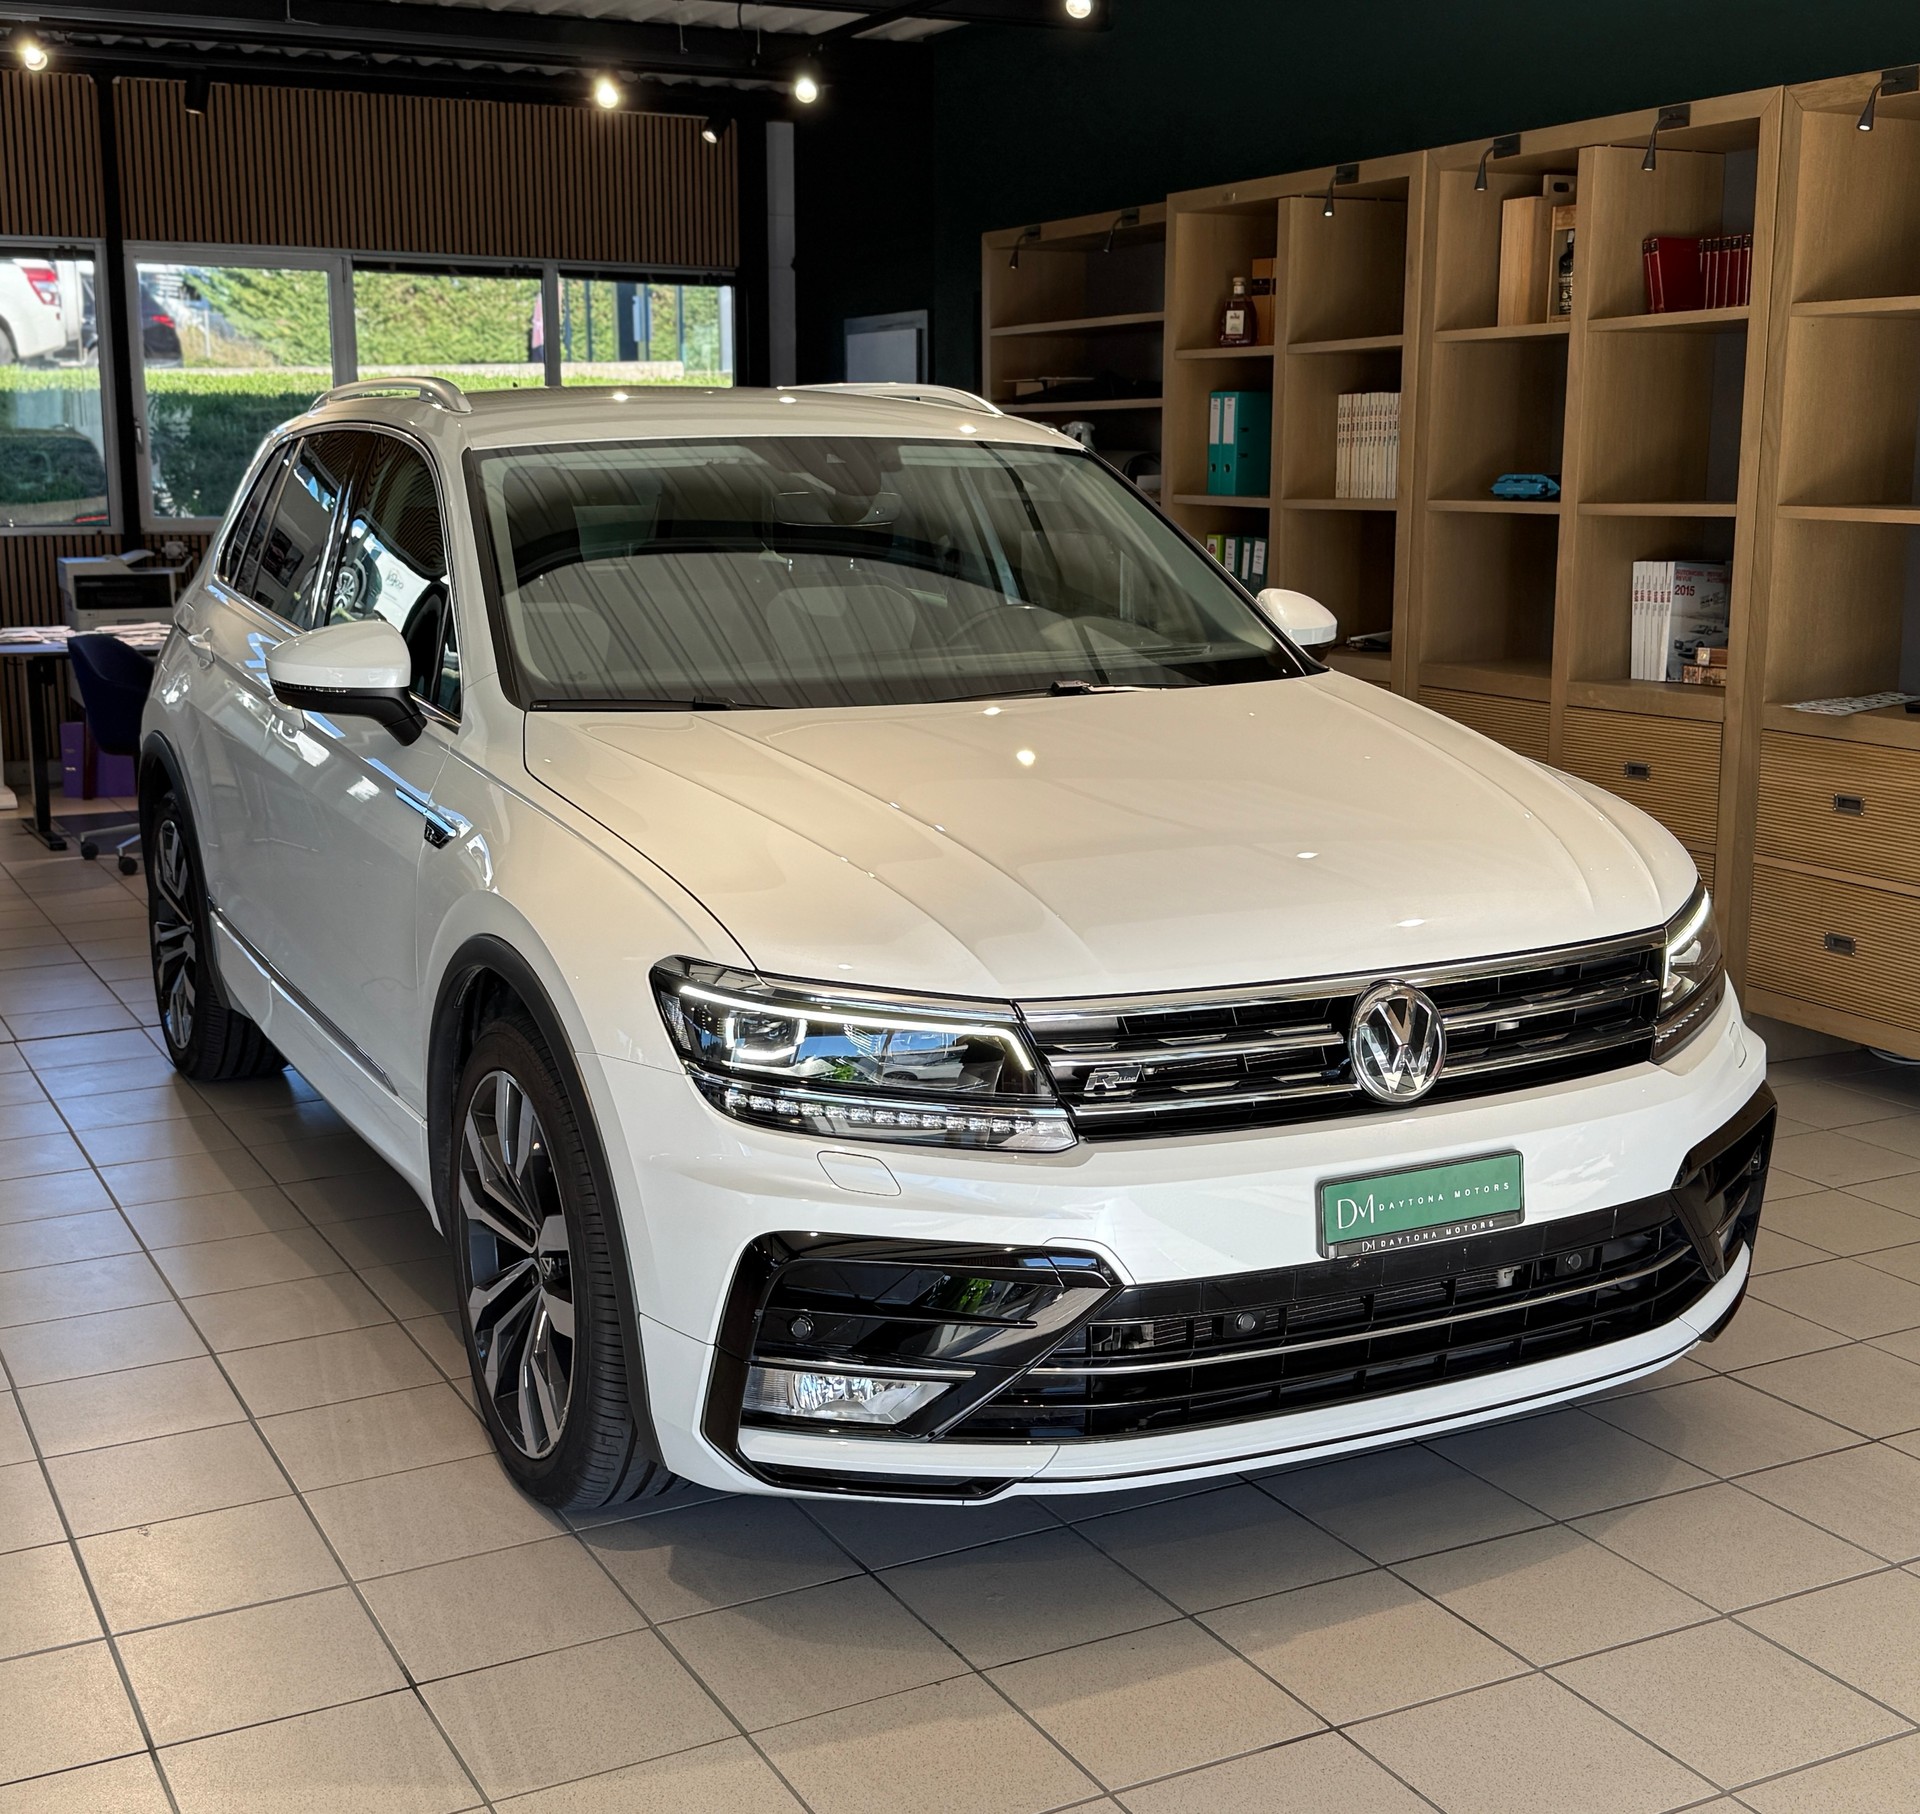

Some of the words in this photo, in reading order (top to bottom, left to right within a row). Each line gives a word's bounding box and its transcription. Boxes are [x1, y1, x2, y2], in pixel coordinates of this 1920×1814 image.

[1674, 584, 1695, 597] 2015
[1379, 1193, 1444, 1211] DAYTONA
[1454, 1182, 1509, 1198] MOTORS
[1381, 1231, 1437, 1247] DAYTONA
[1445, 1220, 1494, 1235] MOTORS
